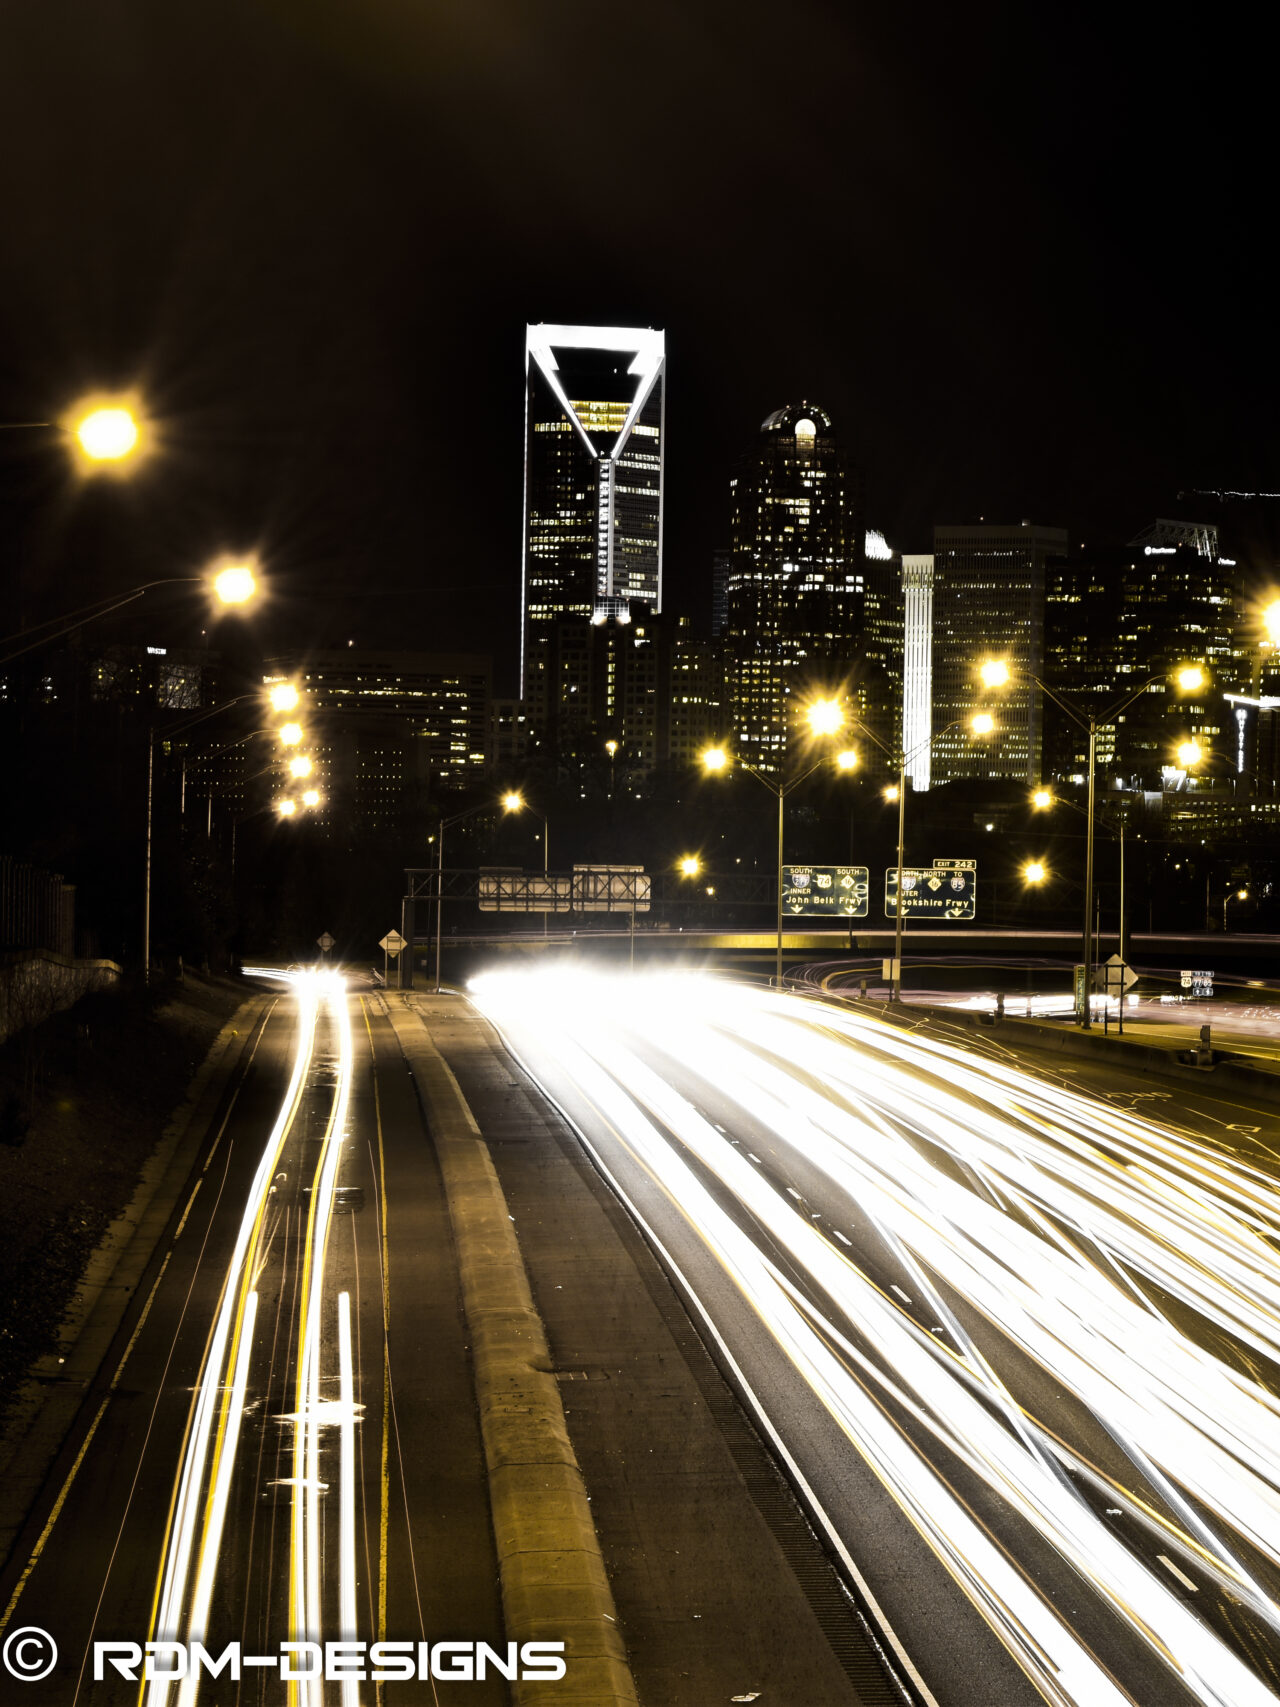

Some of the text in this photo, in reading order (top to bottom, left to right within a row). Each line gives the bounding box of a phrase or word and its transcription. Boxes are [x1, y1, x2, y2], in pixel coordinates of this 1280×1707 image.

[952, 880, 964, 889] 85
[786, 896, 863, 906] John Belk Frwy
[891, 898, 969, 908] Bookshire Frwy
